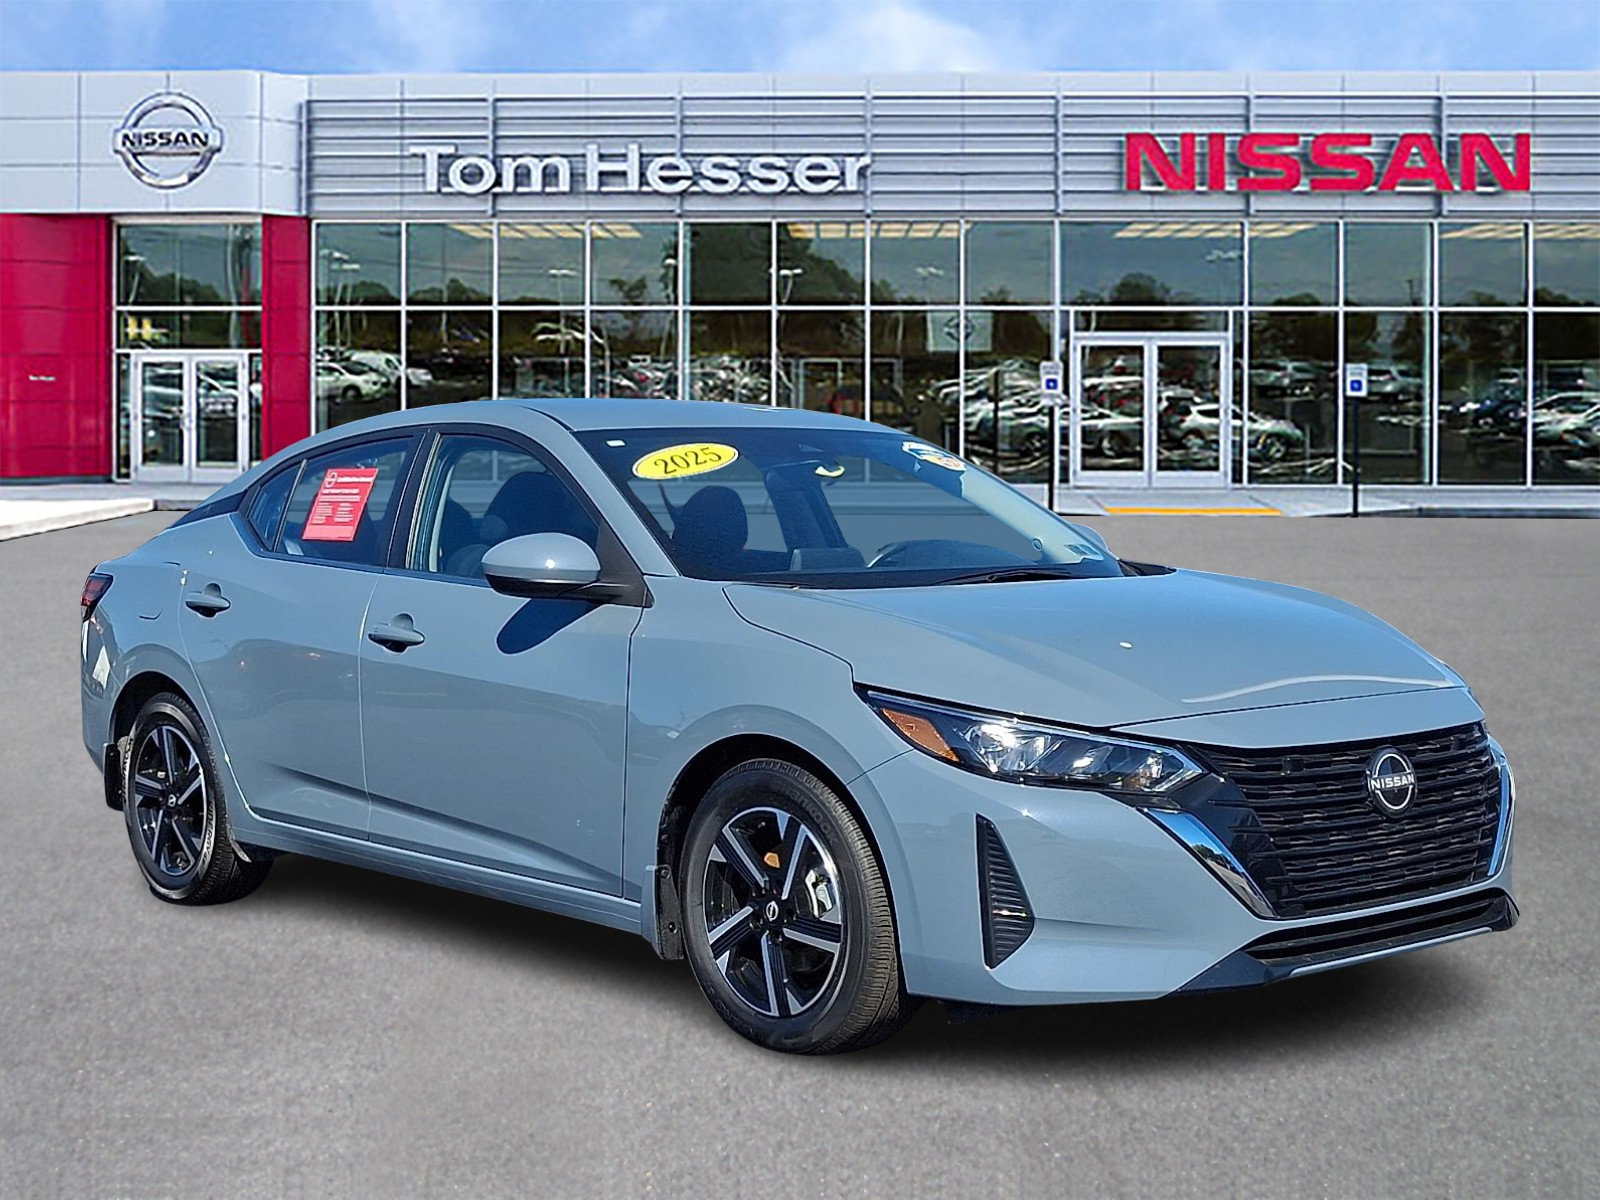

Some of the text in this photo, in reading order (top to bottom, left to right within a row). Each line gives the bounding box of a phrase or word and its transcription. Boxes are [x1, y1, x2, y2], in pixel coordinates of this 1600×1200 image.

[122, 131, 208, 147] NISSAN
[409, 143, 871, 193] Tom Hesser
[1126, 132, 1531, 191] NISSAN
[654, 447, 722, 475] 2025
[1370, 773, 1415, 790] NISSAN
